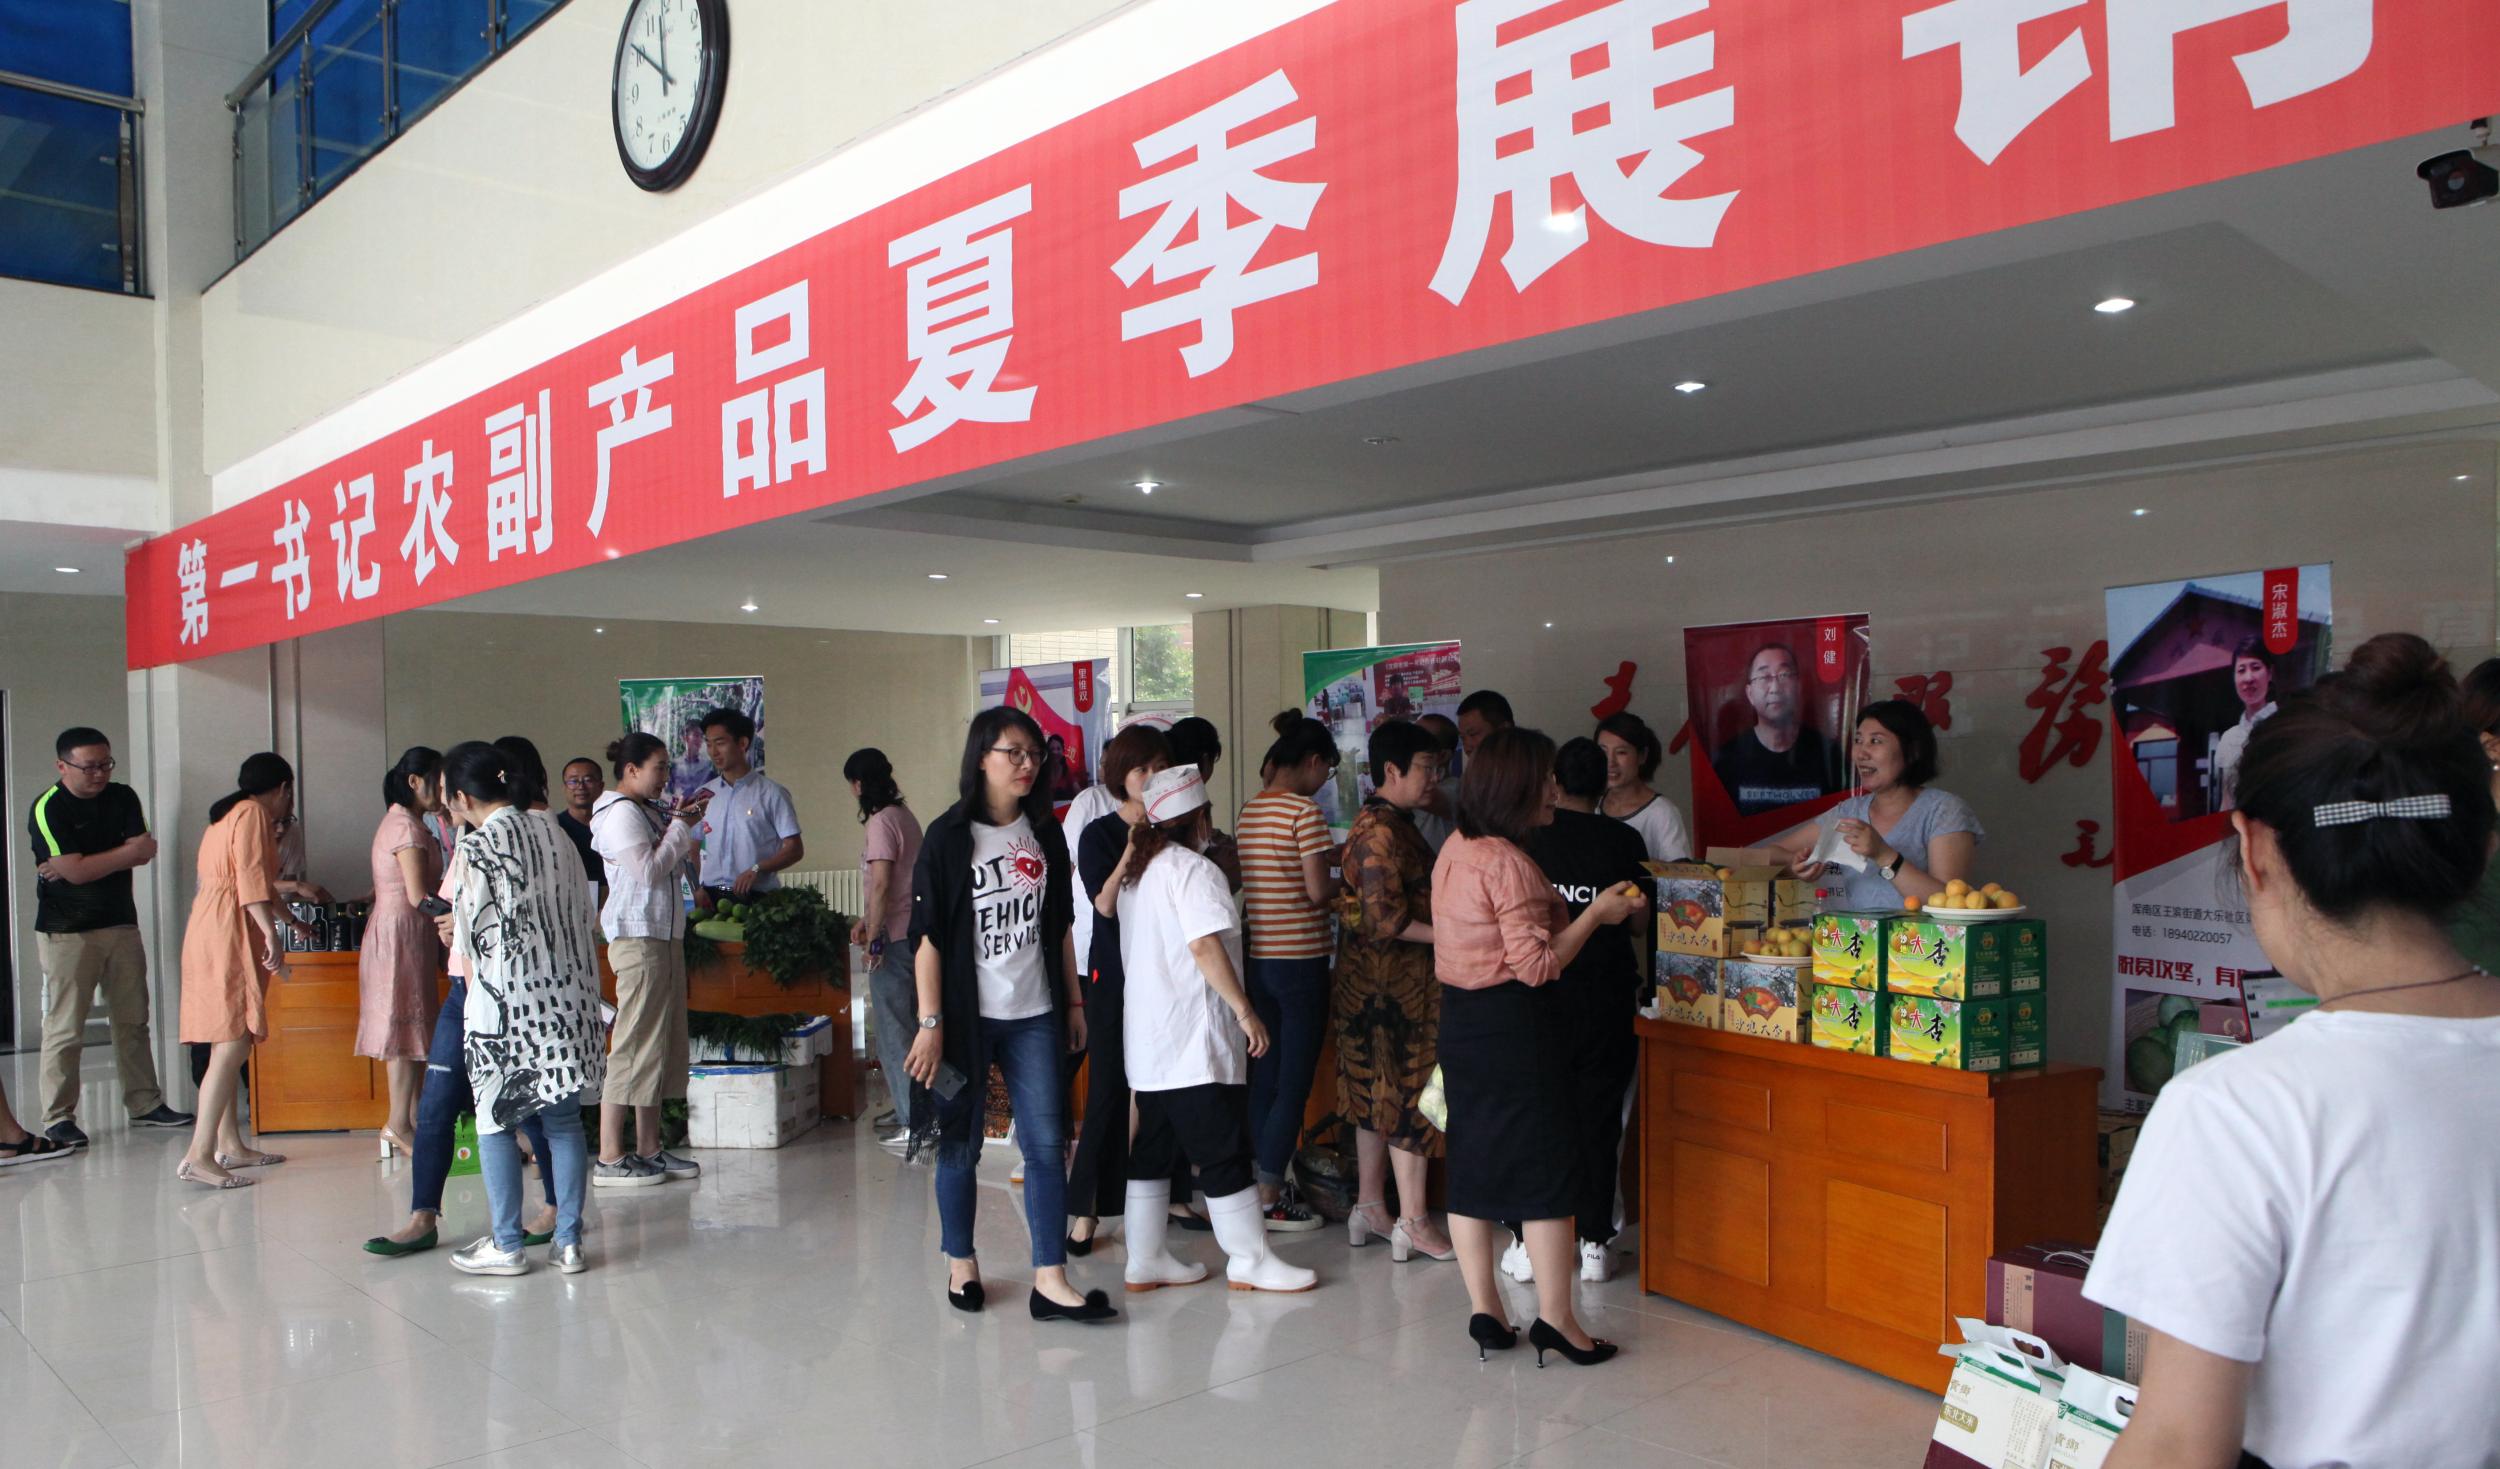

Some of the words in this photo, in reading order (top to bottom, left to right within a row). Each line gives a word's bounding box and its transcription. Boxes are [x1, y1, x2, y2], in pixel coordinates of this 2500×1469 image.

[645, 12, 655, 36] 11
[631, 83, 640, 105] 9
[635, 115, 643, 137] 8
[648, 133, 655, 154] 7
[662, 132, 671, 154] 6
[1823, 627, 1837, 664] 刘健
[2117, 954, 2246, 989] 脱贫攻坚，有
